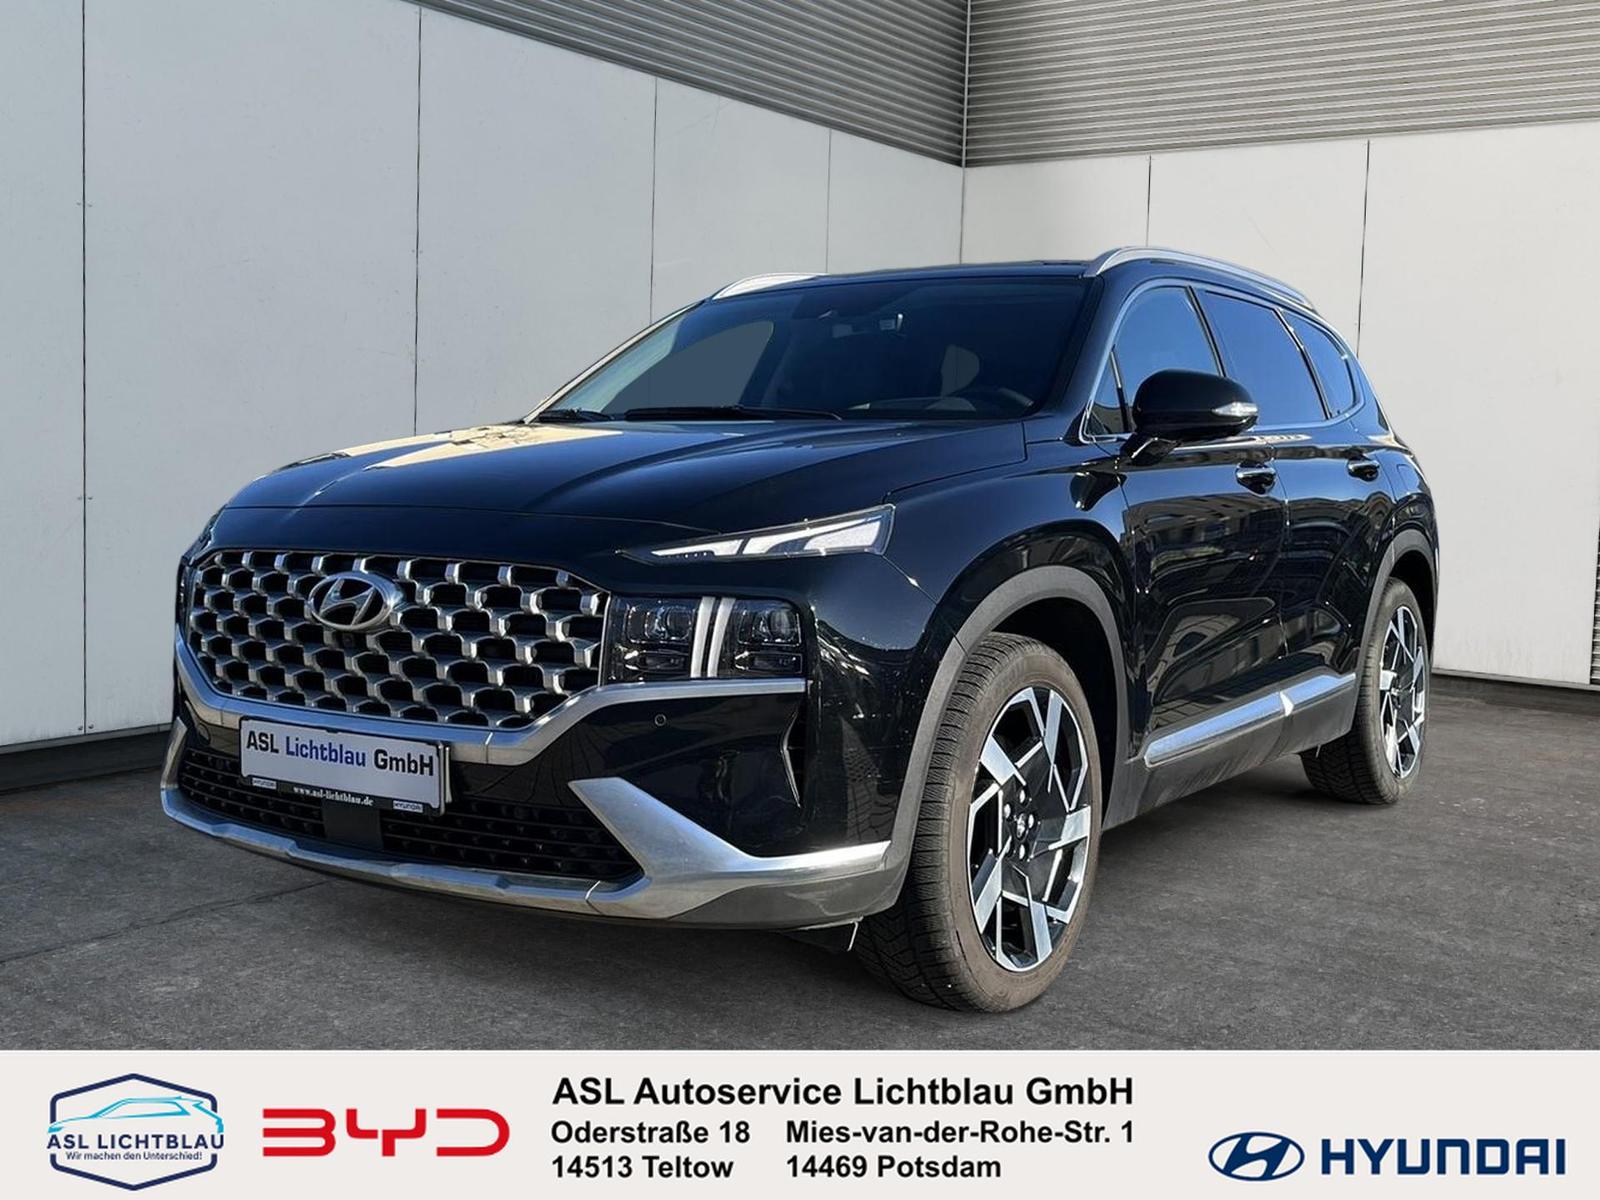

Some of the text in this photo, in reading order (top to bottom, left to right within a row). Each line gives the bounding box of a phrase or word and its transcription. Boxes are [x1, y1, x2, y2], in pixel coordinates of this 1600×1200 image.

[246, 731, 434, 776] ASL Lichtblau GmbH
[293, 786, 374, 806] www.asl-lichtblau.de
